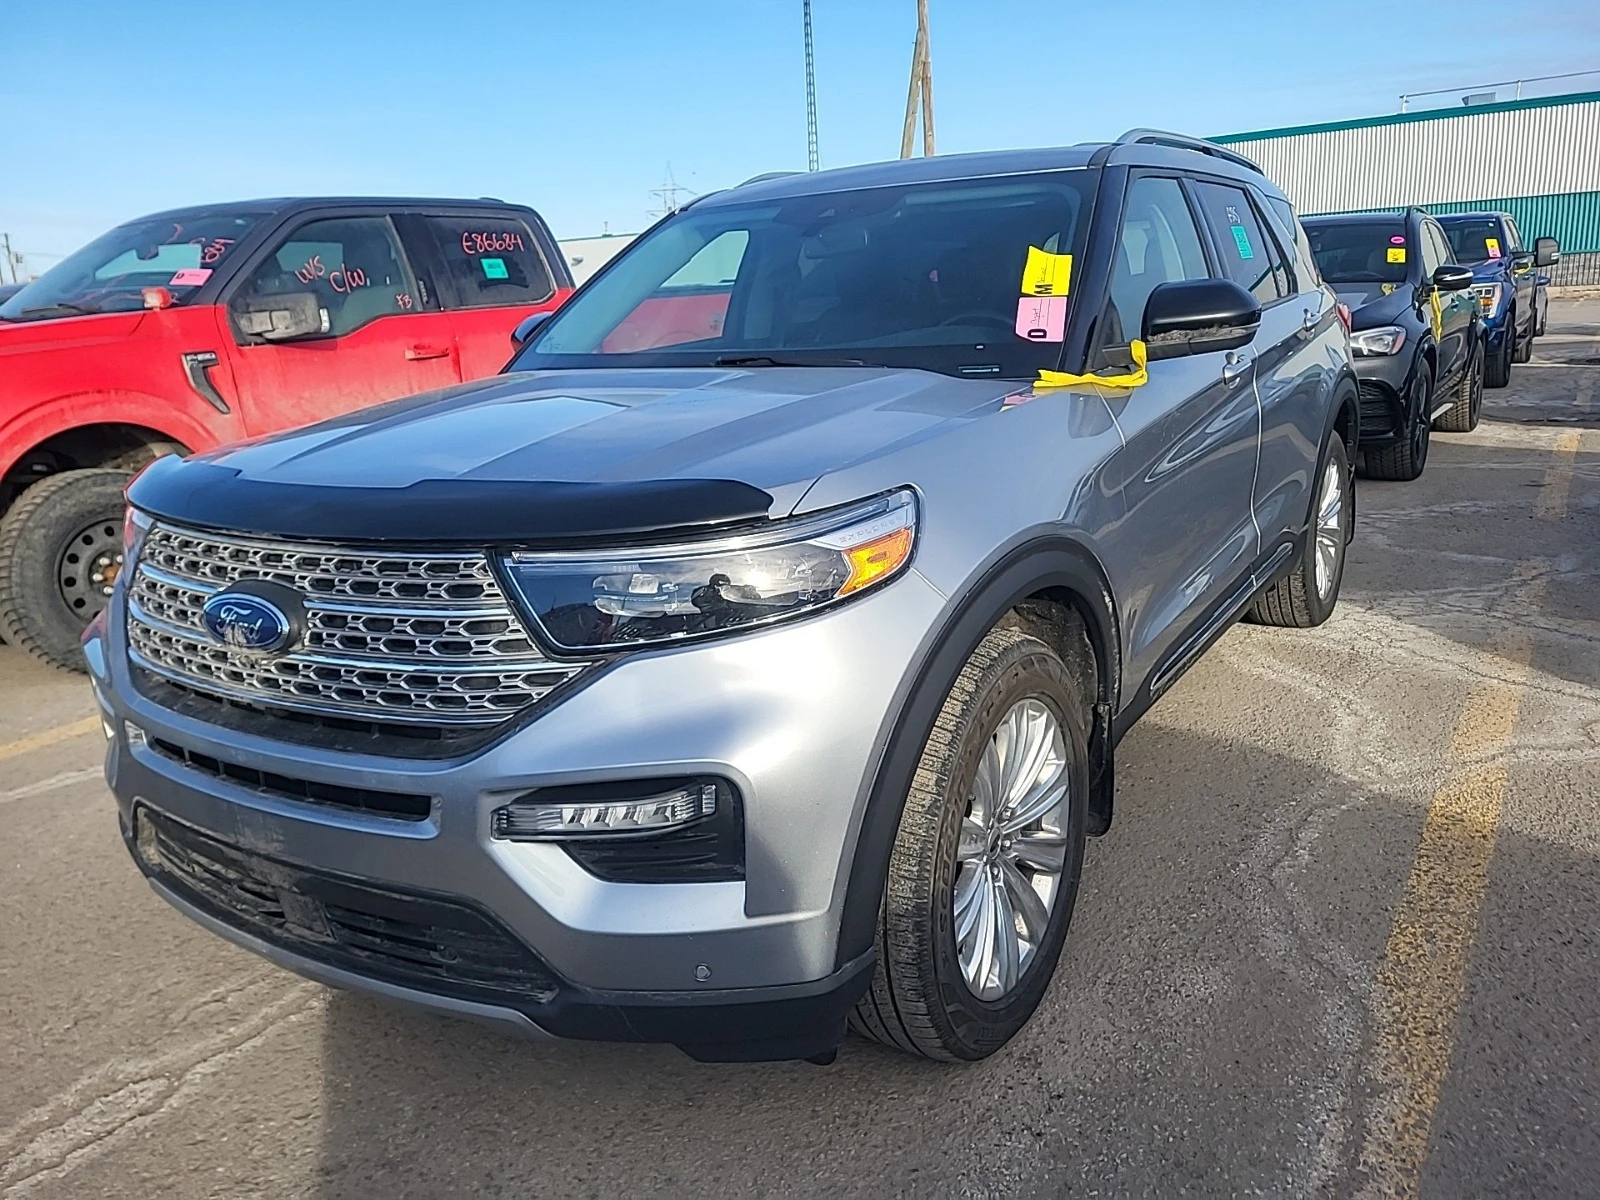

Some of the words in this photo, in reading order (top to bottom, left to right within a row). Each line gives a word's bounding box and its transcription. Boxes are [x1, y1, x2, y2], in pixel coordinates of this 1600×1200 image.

[462, 231, 524, 254] E86684
[1027, 328, 1047, 339] D
[215, 604, 263, 641] Ford
